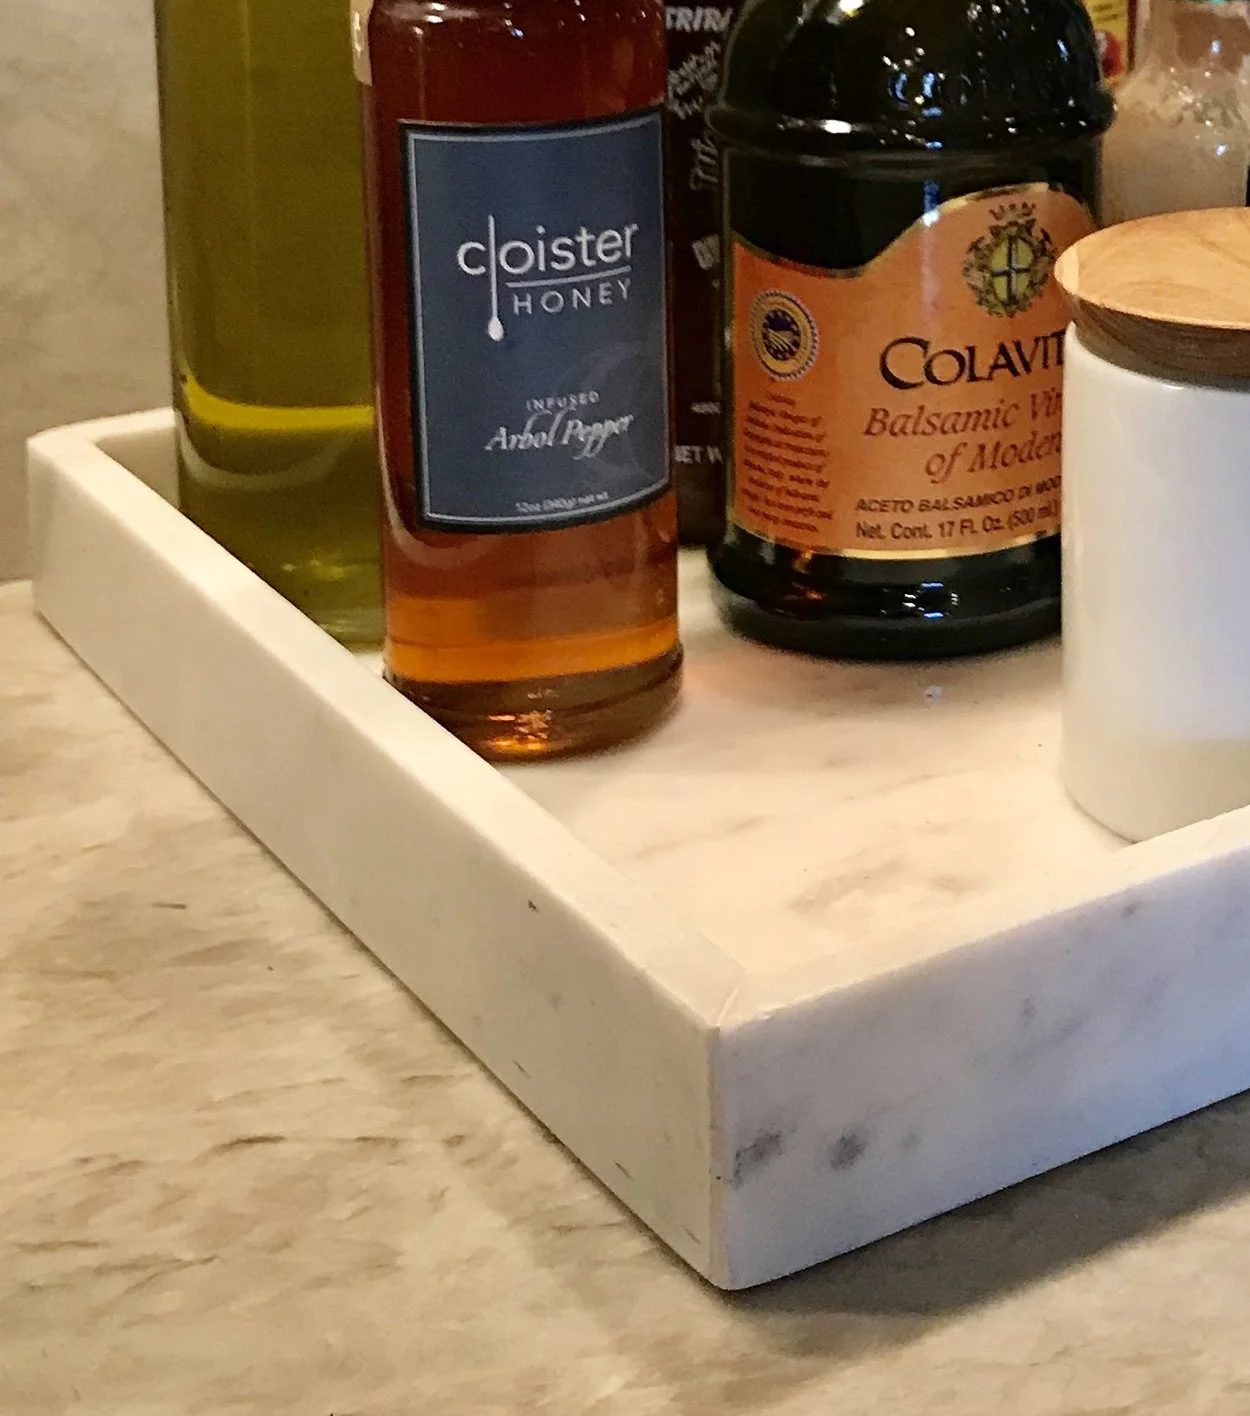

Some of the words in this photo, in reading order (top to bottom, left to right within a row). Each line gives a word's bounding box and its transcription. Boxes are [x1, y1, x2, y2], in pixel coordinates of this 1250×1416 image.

[456, 214, 640, 318] cloister
[512, 277, 632, 316] HONEY
[525, 390, 600, 412] INFUSED
[863, 397, 1020, 437] Balsamic
[484, 405, 577, 451] Arbol
[560, 413, 634, 461] Pepper
[924, 441, 969, 485] of
[855, 498, 915, 514] ACETO
[917, 487, 1015, 513] BALSAMICO
[937, 519, 955, 538] 17
